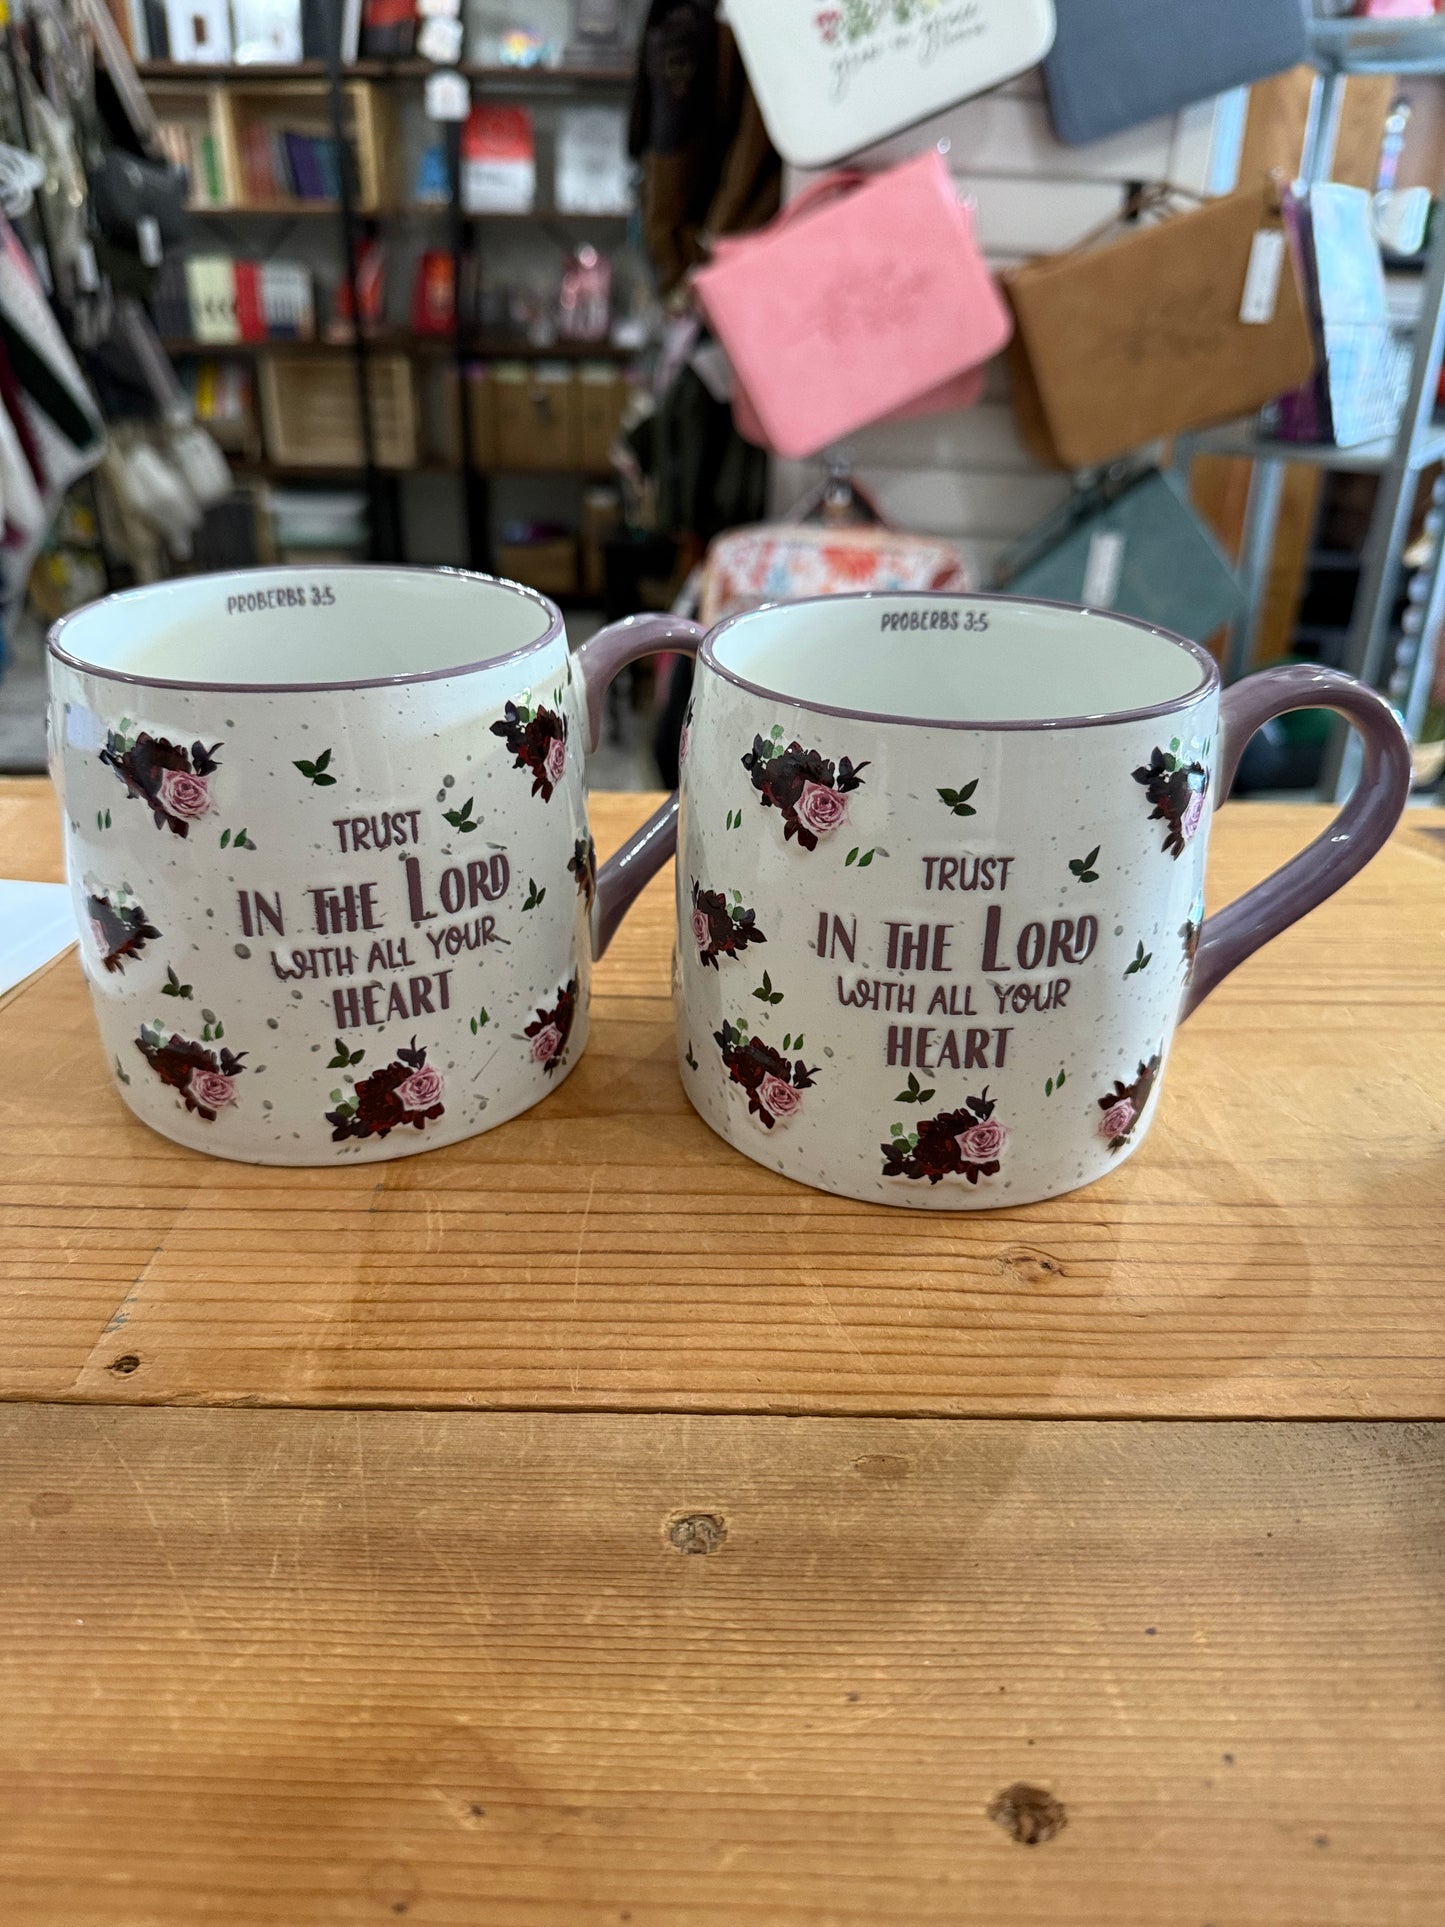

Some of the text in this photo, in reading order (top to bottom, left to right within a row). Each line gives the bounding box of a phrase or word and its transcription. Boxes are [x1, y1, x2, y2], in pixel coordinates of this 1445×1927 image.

[333, 810, 421, 853] TRUST
[922, 857, 1015, 891] TRUST
[238, 890, 285, 937] IN
[307, 882, 384, 935] THE
[271, 915, 496, 980] WITH ALL YOUR
[816, 912, 857, 963] IN
[884, 921, 954, 971] THE
[333, 969, 453, 1029] HEART
[838, 976, 1071, 1016] WITH ALL YOUR
[886, 1025, 1014, 1069] HEART
